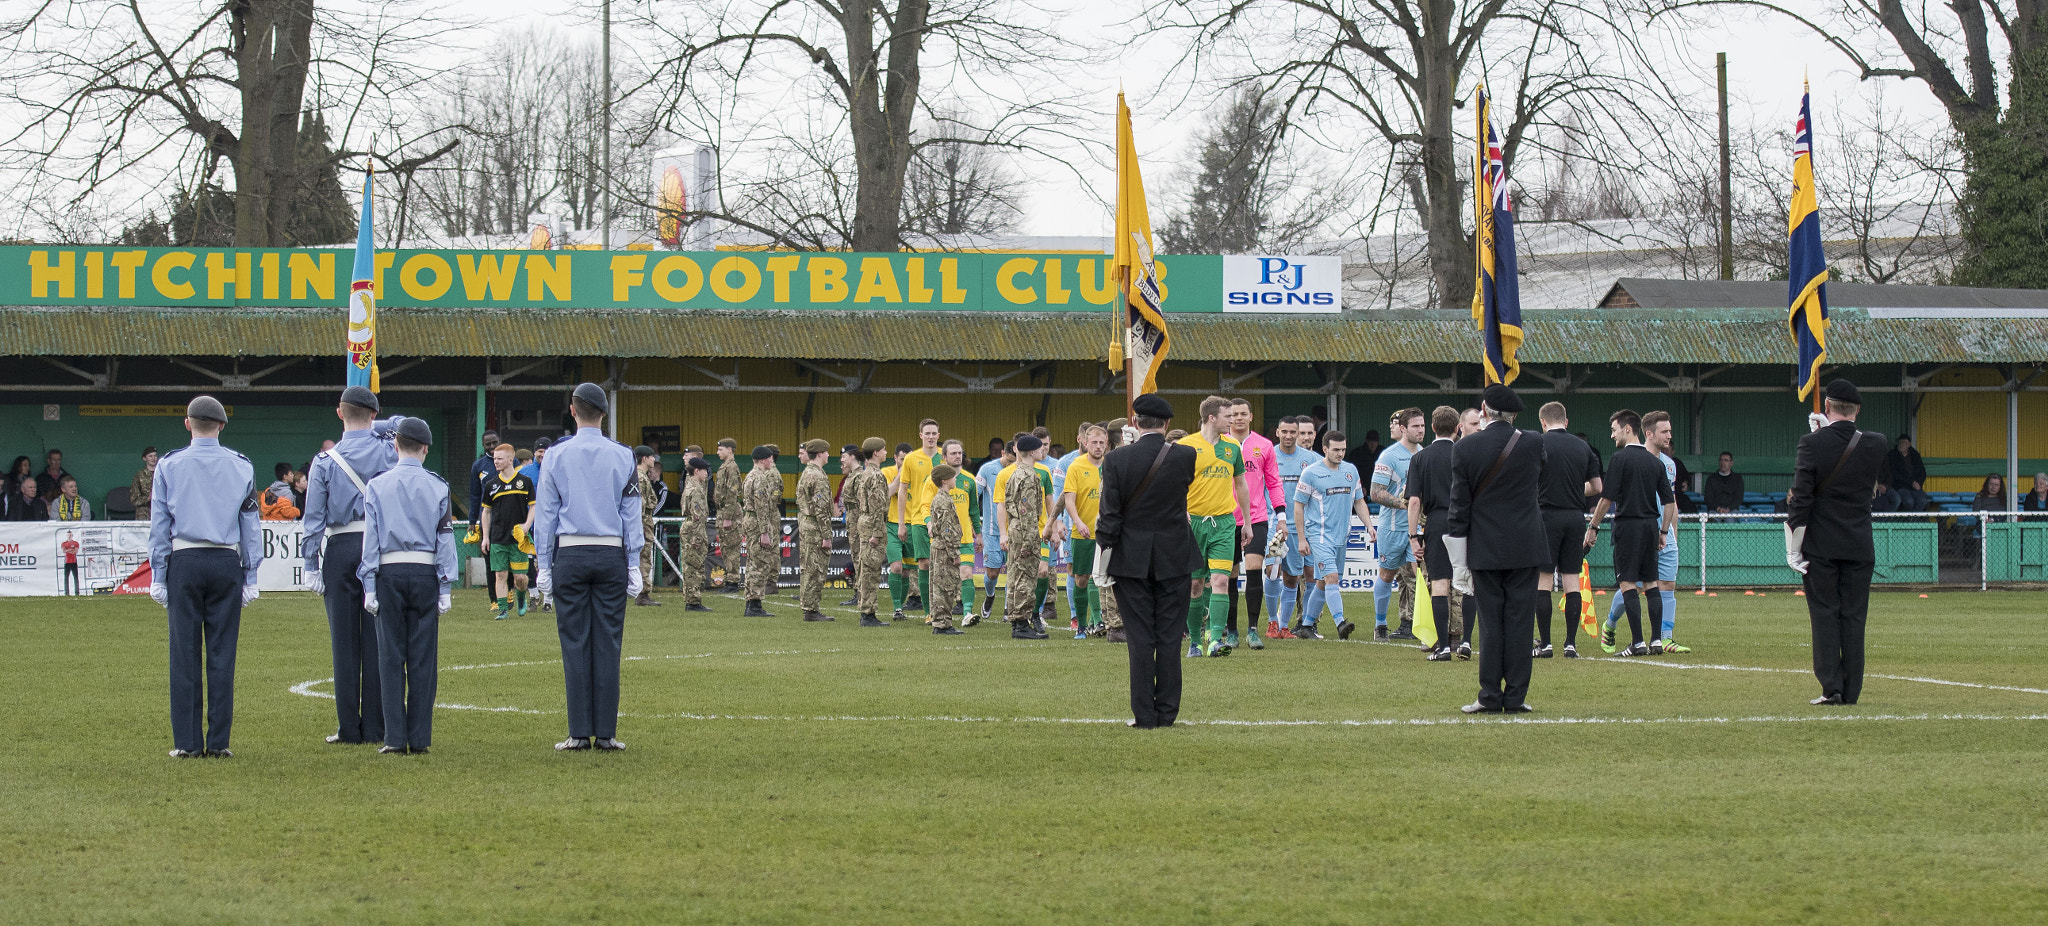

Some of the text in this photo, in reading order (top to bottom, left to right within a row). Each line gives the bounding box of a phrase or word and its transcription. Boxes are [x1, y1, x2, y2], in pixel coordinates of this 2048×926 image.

[28, 251, 335, 300] HITCHIN
[374, 252, 571, 302] TOWN
[609, 254, 967, 305] FOOTBALL
[1257, 257, 1307, 291] P&J
[1228, 291, 1334, 306] SIGNS
[0, 555, 37, 566] NEED
